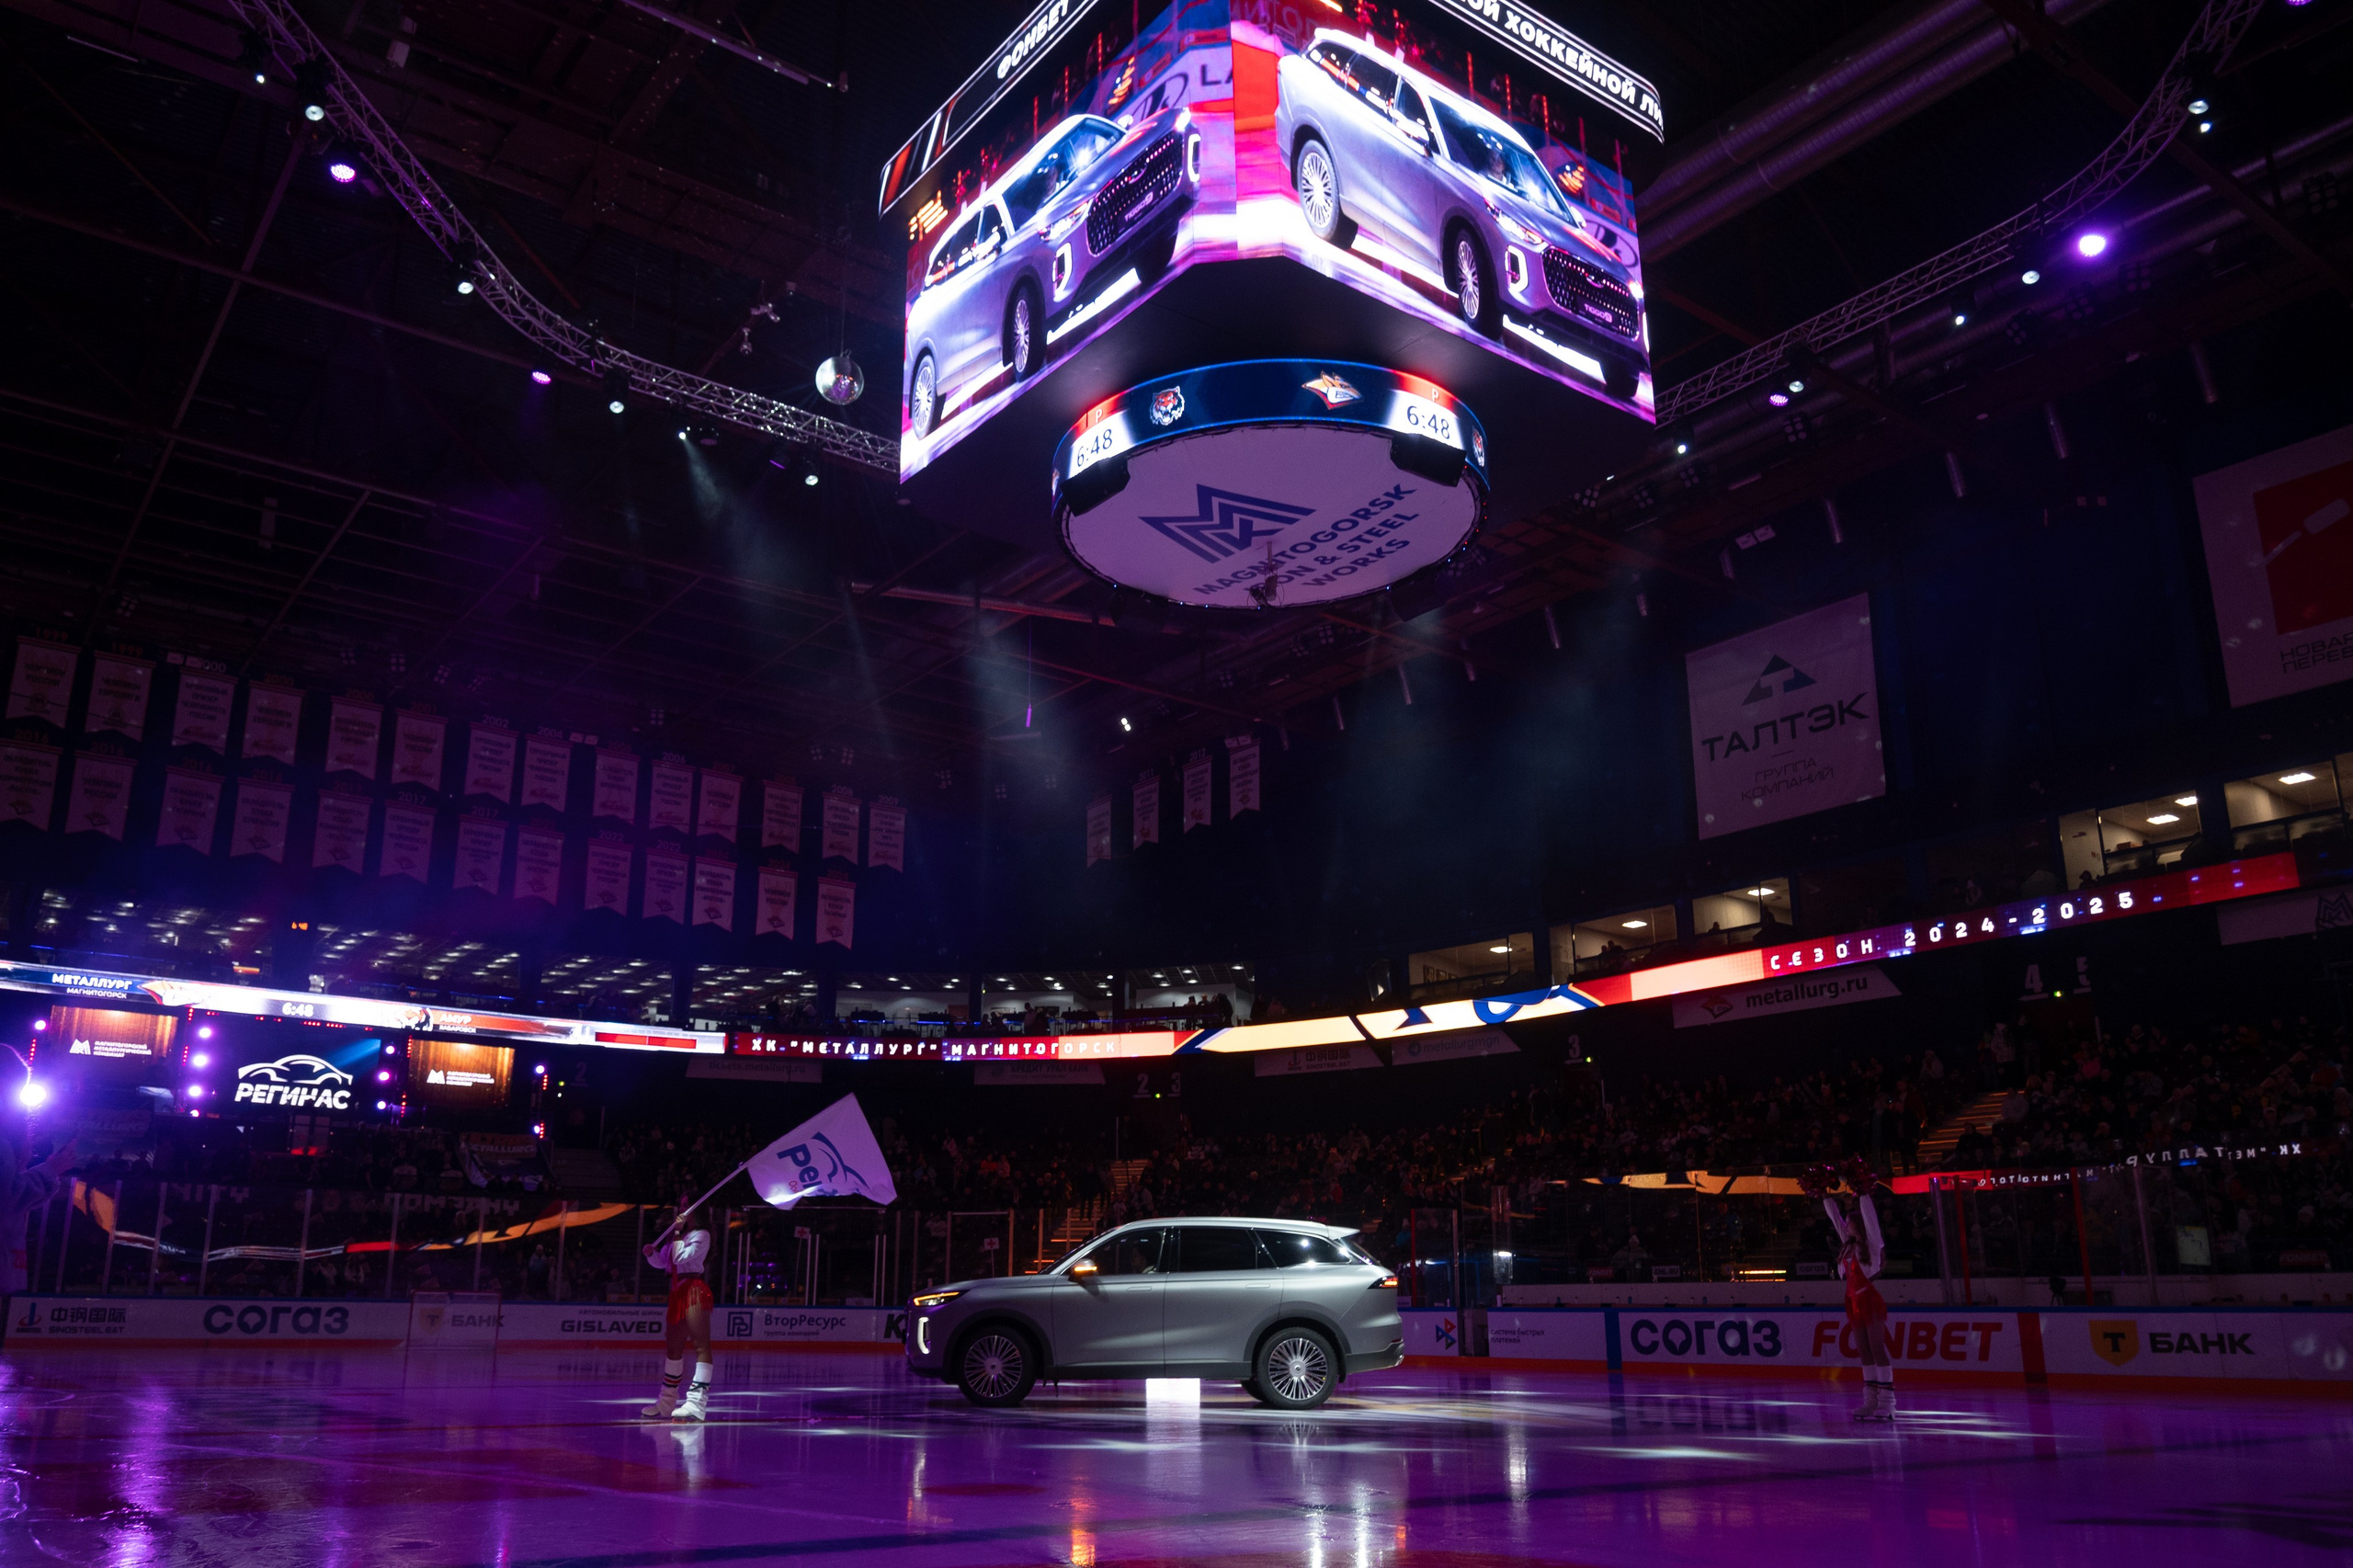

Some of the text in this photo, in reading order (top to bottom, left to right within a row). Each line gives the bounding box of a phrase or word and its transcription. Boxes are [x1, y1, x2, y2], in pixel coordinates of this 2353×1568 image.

[1505, 10, 1636, 104] ХОККЕЙНОЙ
[1407, 405, 1450, 439] 6:48
[1076, 428, 1113, 467] 6:48
[1336, 513, 1420, 553] STEEL
[1302, 539, 1410, 586] WORKS
[483, 714, 509, 728] 2002
[1701, 692, 1870, 762] ТАЛТЭК
[538, 725, 563, 739] 2004
[662, 751, 687, 764] 2006
[1755, 758, 1817, 782] ГРУППА
[1741, 766, 1834, 801] КОМПАНИЙ
[599, 829, 624, 842] 2022
[656, 839, 682, 852] 2022
[1770, 892, 2133, 970] СЕЗОН 2024-2025
[52, 973, 132, 991] МЕТАЛЛУРГ
[2025, 964, 2043, 993] 4
[66, 987, 127, 999] МАГНИТОГОРСК
[1746, 977, 1868, 1007] metallurg.ru
[282, 1002, 314, 1017] 6:48
[751, 1039, 777, 1051] ХК
[951, 1041, 1115, 1056] МАГНИТОГОРСК
[1305, 1049, 1350, 1061] 中钢国际
[1568, 1034, 1580, 1058] 3
[574, 1062, 586, 1082] 2
[1137, 1074, 1149, 1093] 2
[1171, 1072, 1181, 1092] 3
[234, 1082, 351, 1110] РЕГИНАС
[51, 1307, 126, 1324] 中钢国际
[451, 1314, 505, 1327] БАНК
[764, 1314, 847, 1330] ВторРесурс
[561, 1320, 663, 1334] GISLAVED
[1518, 1327, 1545, 1337] быстрых
[1491, 1335, 1521, 1344] платежей
[2150, 1333, 2255, 1355] БАНК
